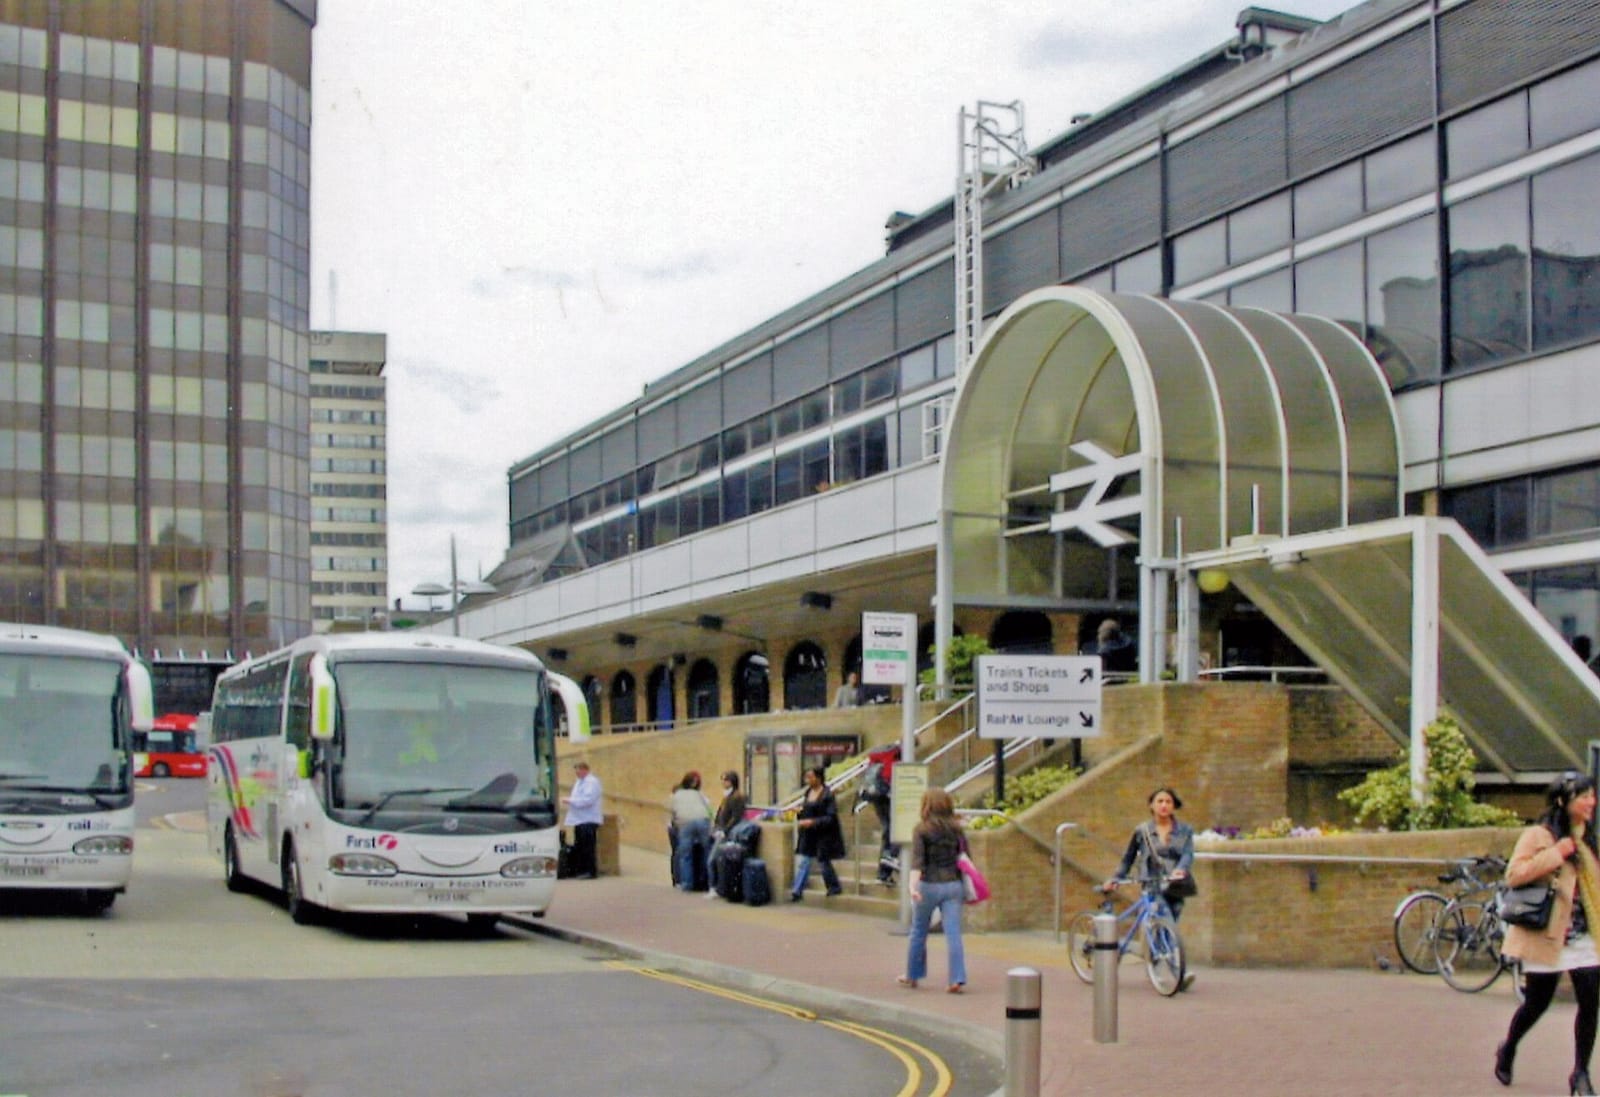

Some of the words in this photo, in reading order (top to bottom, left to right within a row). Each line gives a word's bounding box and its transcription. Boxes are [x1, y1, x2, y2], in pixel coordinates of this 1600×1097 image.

[986, 665, 1023, 679] Trains
[1027, 666, 1068, 679] Tickets
[986, 681, 1009, 692] and
[1012, 680, 1049, 694] Shops
[1027, 713, 1070, 727] Lounge
[346, 835, 376, 849] First
